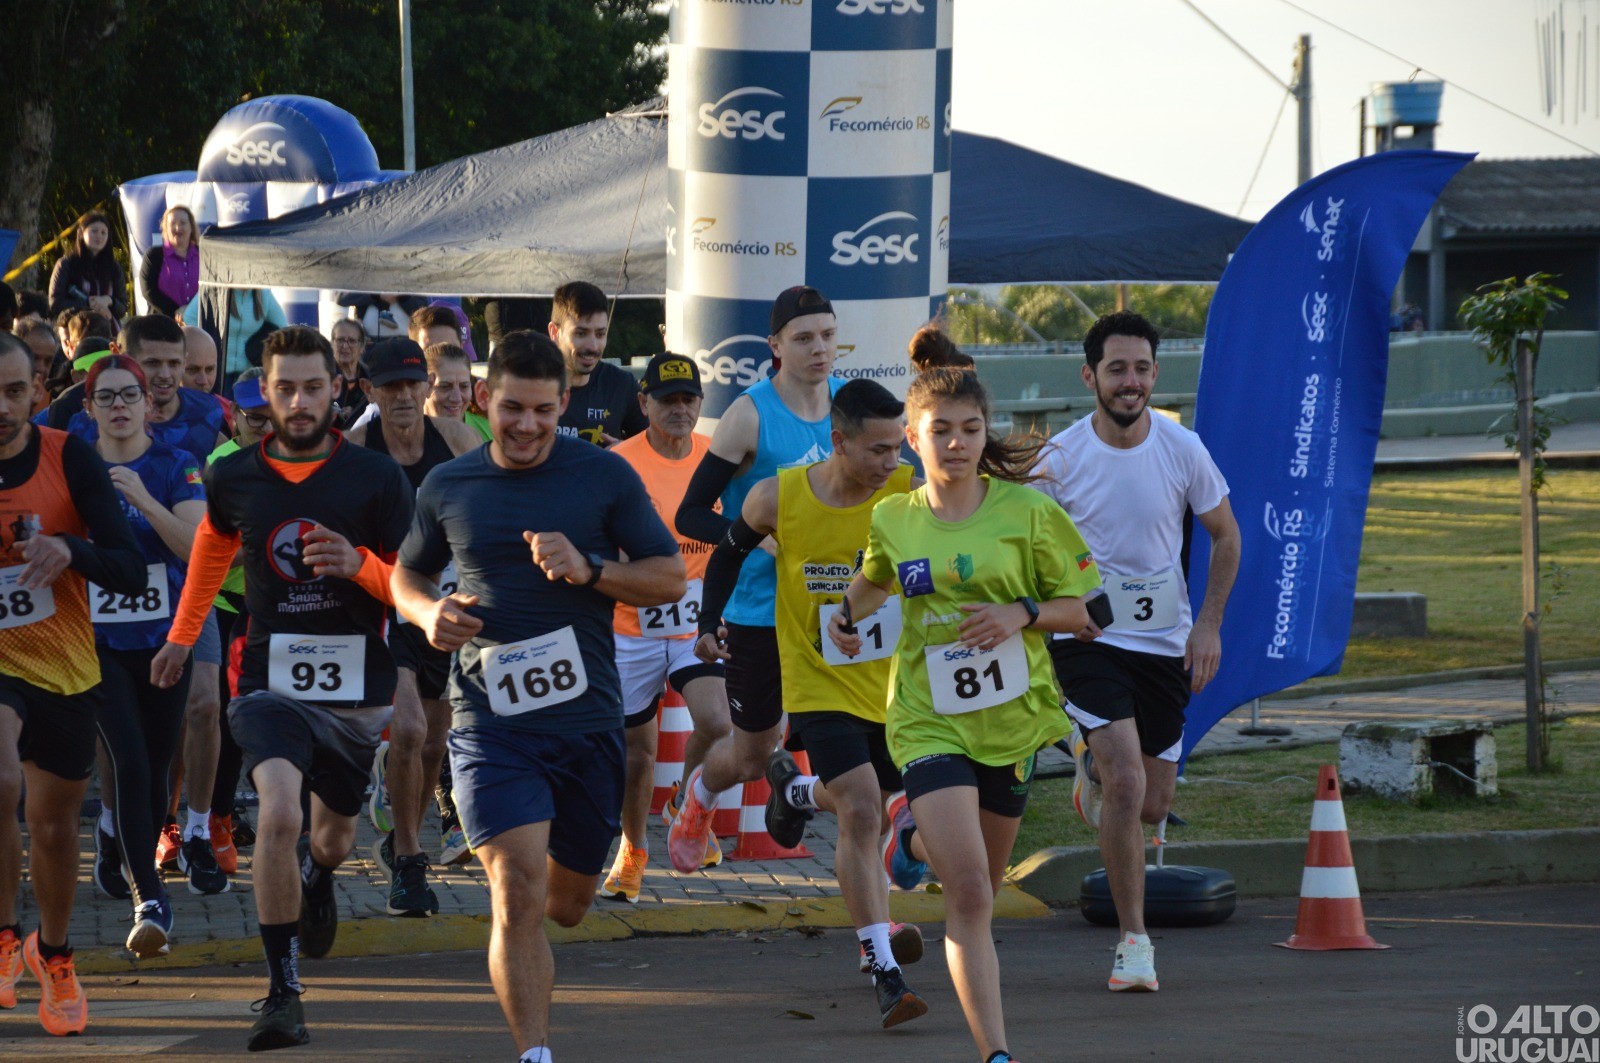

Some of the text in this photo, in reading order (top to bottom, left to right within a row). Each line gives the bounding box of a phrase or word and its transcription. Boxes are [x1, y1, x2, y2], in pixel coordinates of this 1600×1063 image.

[829, 117, 931, 132] Fecomércio RS
[693, 237, 770, 256] Fecomércio
[775, 241, 797, 256] RS
[829, 363, 906, 380] ecomércio
[1290, 373, 1320, 478] Sindicatos
[1324, 377, 1342, 488] Sistema Comércio
[1282, 507, 1303, 537] RS
[804, 566, 850, 576] PROJETO
[97, 587, 161, 614] 248
[645, 600, 702, 629] 213
[1134, 597, 1153, 621] 3
[1266, 542, 1299, 660] Fecomércio
[291, 662, 342, 691] 93
[497, 659, 577, 704] 168
[954, 659, 1004, 699] 81
[791, 783, 810, 806] RUN
